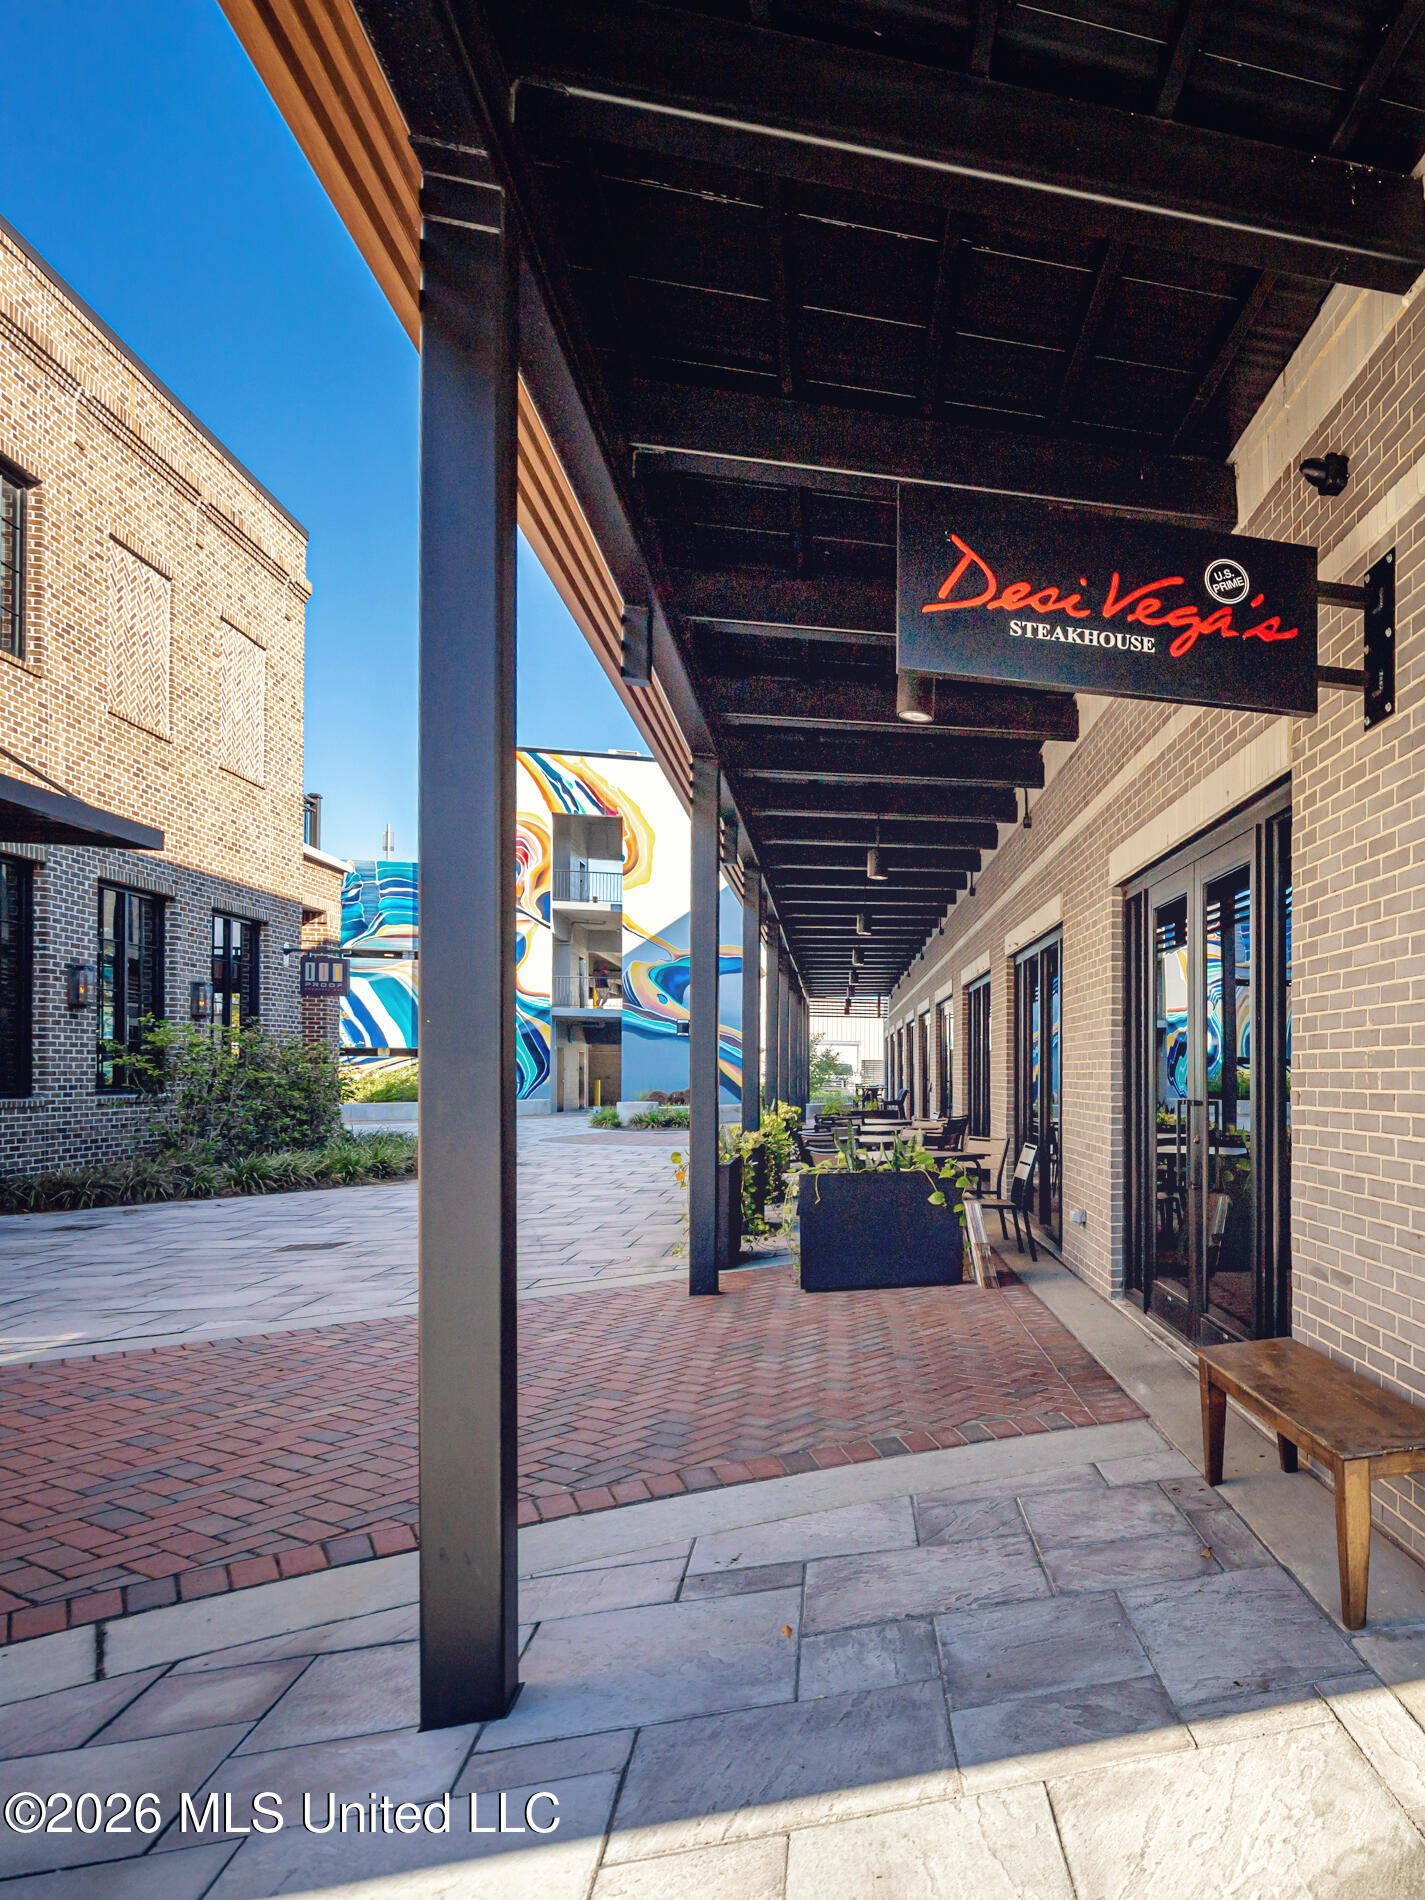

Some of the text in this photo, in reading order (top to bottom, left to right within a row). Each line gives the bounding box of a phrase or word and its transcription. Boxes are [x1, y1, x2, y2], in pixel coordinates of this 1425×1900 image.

[1212, 576, 1245, 593] PRIME
[1213, 569, 1236, 582] U.S.
[920, 532, 1299, 658] Desi Vega's
[1009, 619, 1156, 654] STEAKHOUSE
